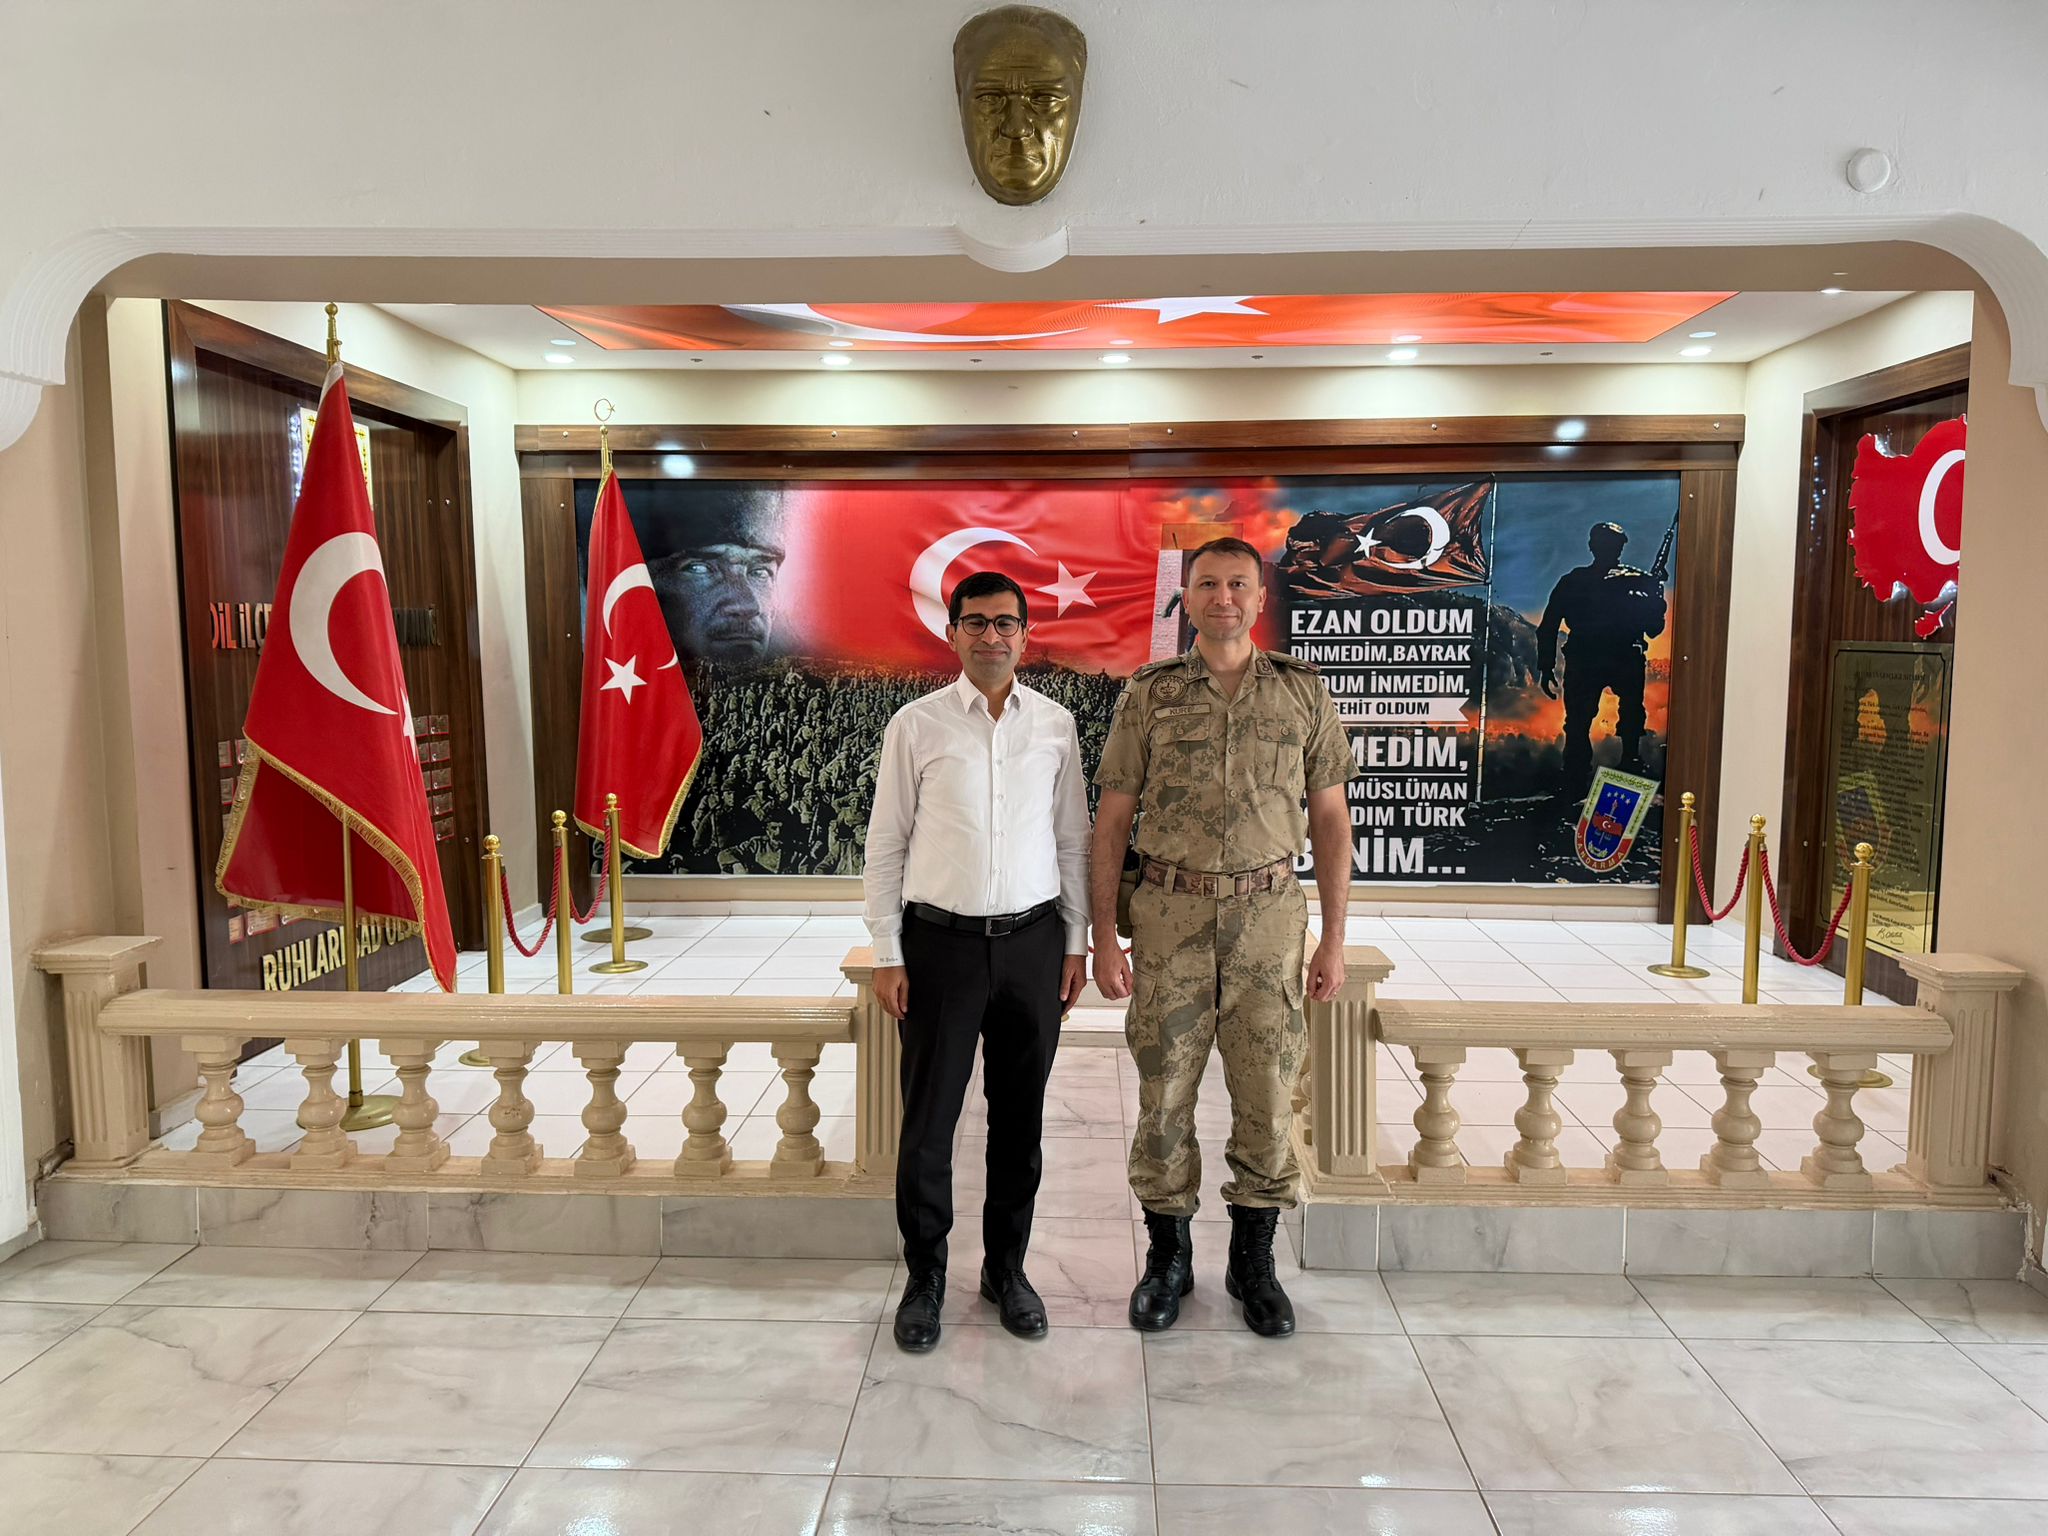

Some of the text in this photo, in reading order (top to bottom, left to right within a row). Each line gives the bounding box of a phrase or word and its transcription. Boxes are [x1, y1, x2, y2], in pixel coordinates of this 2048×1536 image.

[1291, 609, 1473, 634] EZAN OLDUM
[1321, 671, 1470, 695] DUM İNMEDİM,
[1376, 702, 1430, 715] OLDUM
[1350, 729, 1468, 771] MEDİM,
[1348, 778, 1468, 800] MÜSLÜMAN
[1401, 802, 1466, 827] TÜRK
[263, 926, 346, 991] RUHLARI
[356, 916, 382, 959] AD
